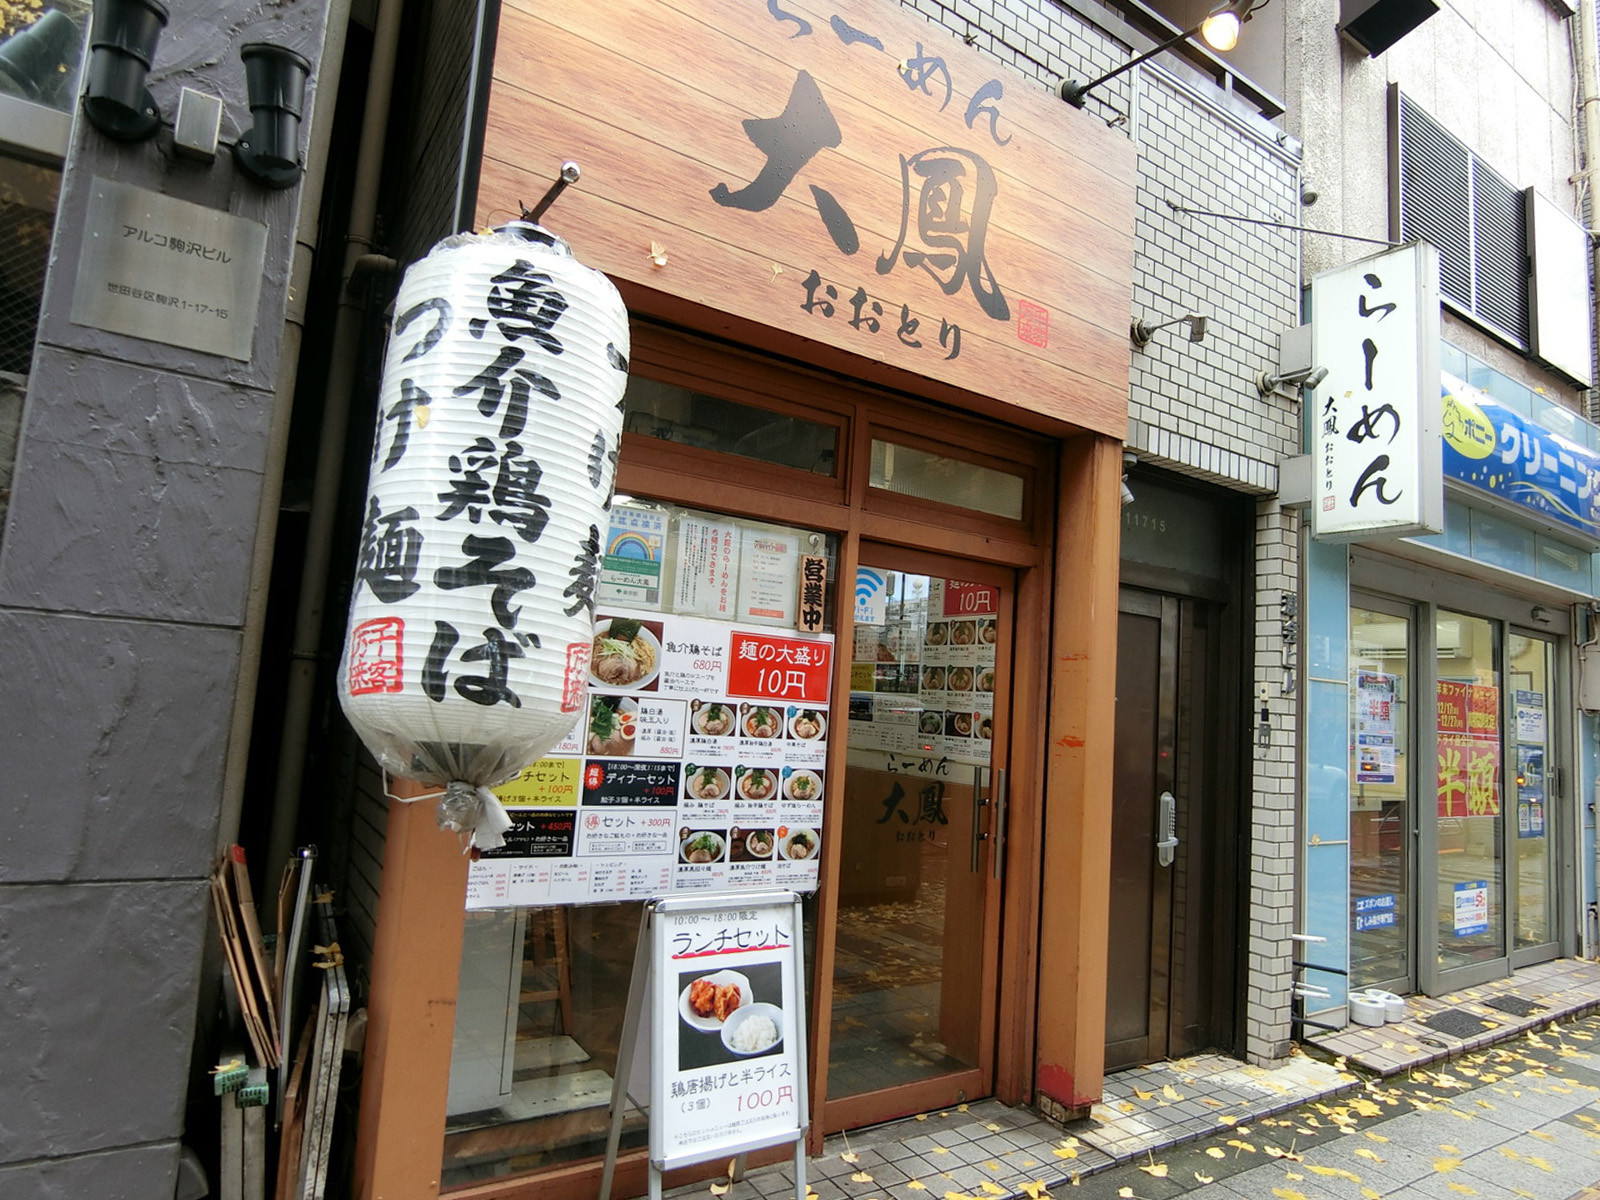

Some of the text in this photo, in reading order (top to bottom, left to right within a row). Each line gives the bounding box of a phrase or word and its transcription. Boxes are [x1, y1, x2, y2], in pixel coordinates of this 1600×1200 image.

[767, 0, 1012, 146] らーめん
[709, 69, 1012, 322] 大鳳
[123, 224, 232, 265] アルコ駒沢ビル
[106, 282, 229, 320] 世田谷区駒沢1-17-15
[801, 269, 962, 361] おおとり
[1346, 273, 1404, 508] らーめん
[1321, 396, 1340, 440] 大鳳
[1464, 418, 1493, 445] ポニー
[357, 296, 453, 604] つけ麺
[420, 258, 570, 709] 魚介鶏そば
[803, 557, 826, 632] 営業中
[960, 590, 991, 612] 10円
[666, 641, 723, 657] 魚介鶏そば
[693, 660, 722, 672] 680円
[738, 639, 826, 667] 麺の大盛り
[757, 668, 806, 698] 10円
[519, 771, 570, 783] チセット
[606, 773, 675, 785] ディナーセット
[887, 754, 949, 776] らーめん
[1437, 748, 1500, 817] 半額
[602, 816, 636, 827] セット
[876, 781, 949, 826] 大鳳
[672, 924, 789, 955] ランチセット
[670, 1063, 791, 1099] 鶏唐揚げと半ライス
[737, 1085, 793, 1112] 100円
